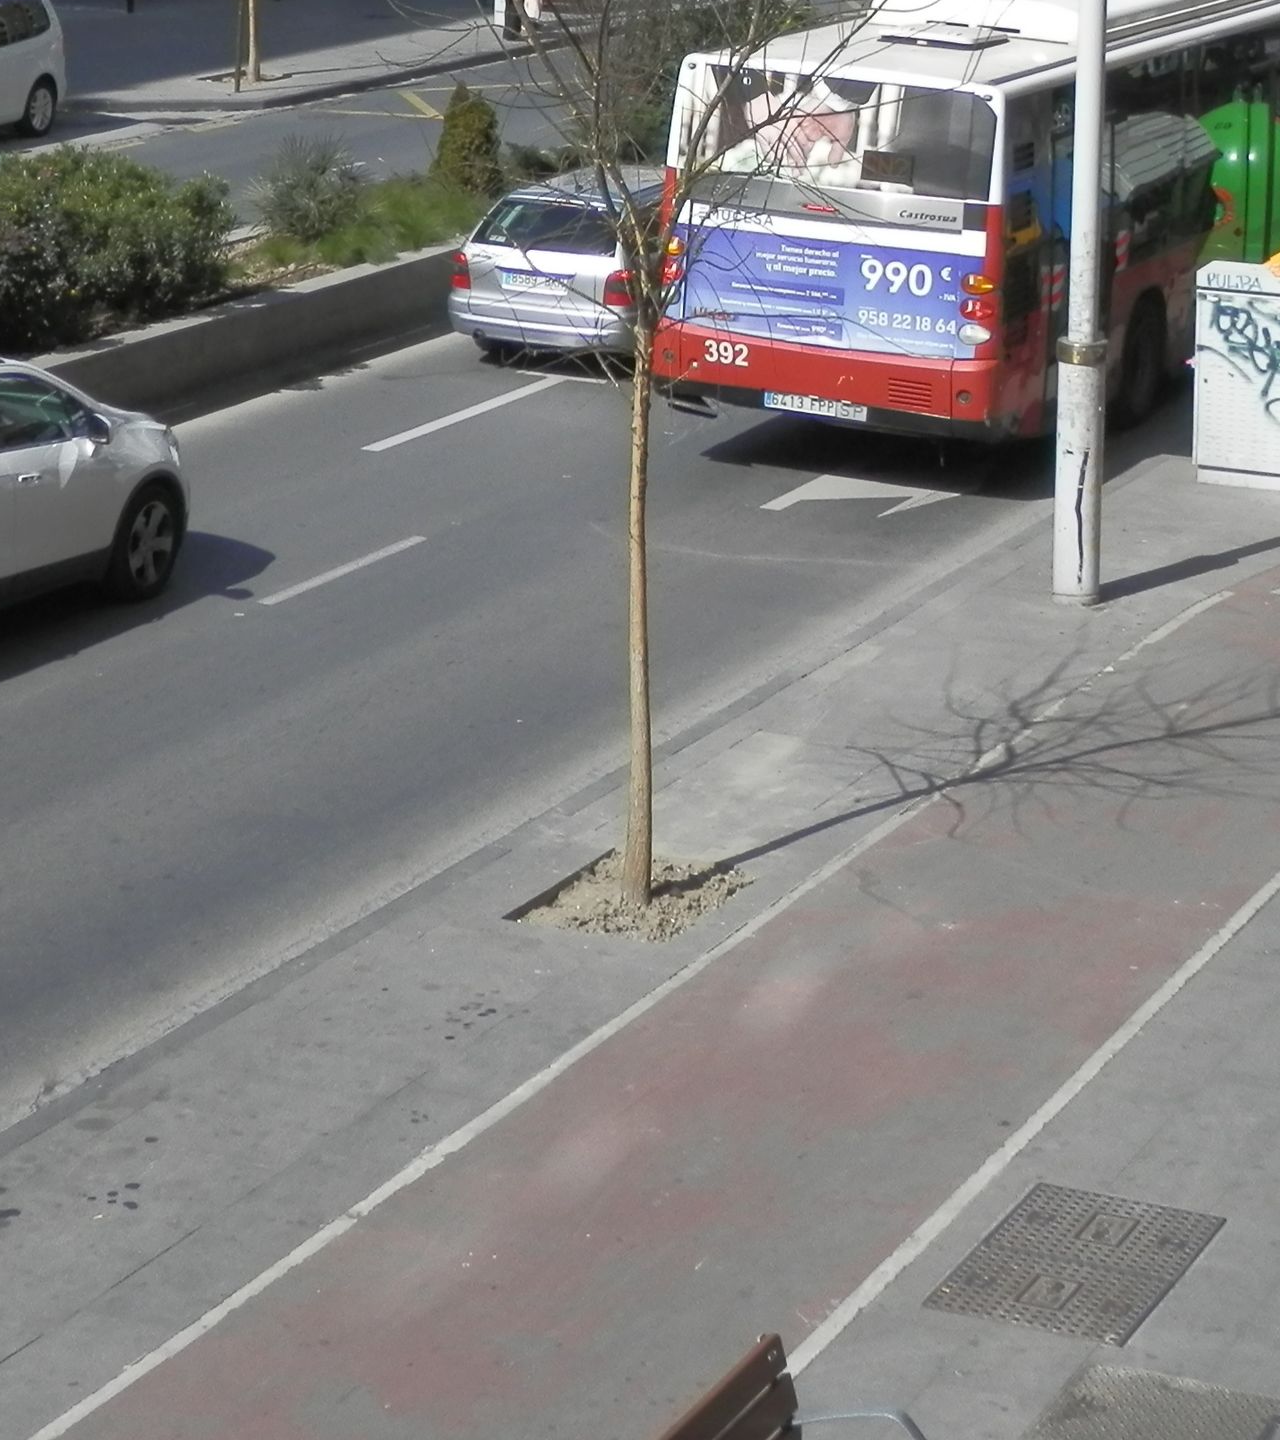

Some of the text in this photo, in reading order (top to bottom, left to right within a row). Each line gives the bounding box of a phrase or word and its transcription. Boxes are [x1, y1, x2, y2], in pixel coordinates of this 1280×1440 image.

[899, 210, 958, 223] Castrosua
[777, 253, 804, 263] servicio
[804, 247, 831, 257] derecho
[765, 263, 772, 272] y
[773, 262, 781, 271] al
[783, 264, 808, 276] mejor
[861, 258, 933, 297] 990
[940, 266, 952, 281] €
[858, 309, 957, 336] 958 22 18 64
[704, 339, 749, 367] 392
[771, 392, 834, 413] 6413 FPP
[840, 405, 864, 417] SP
